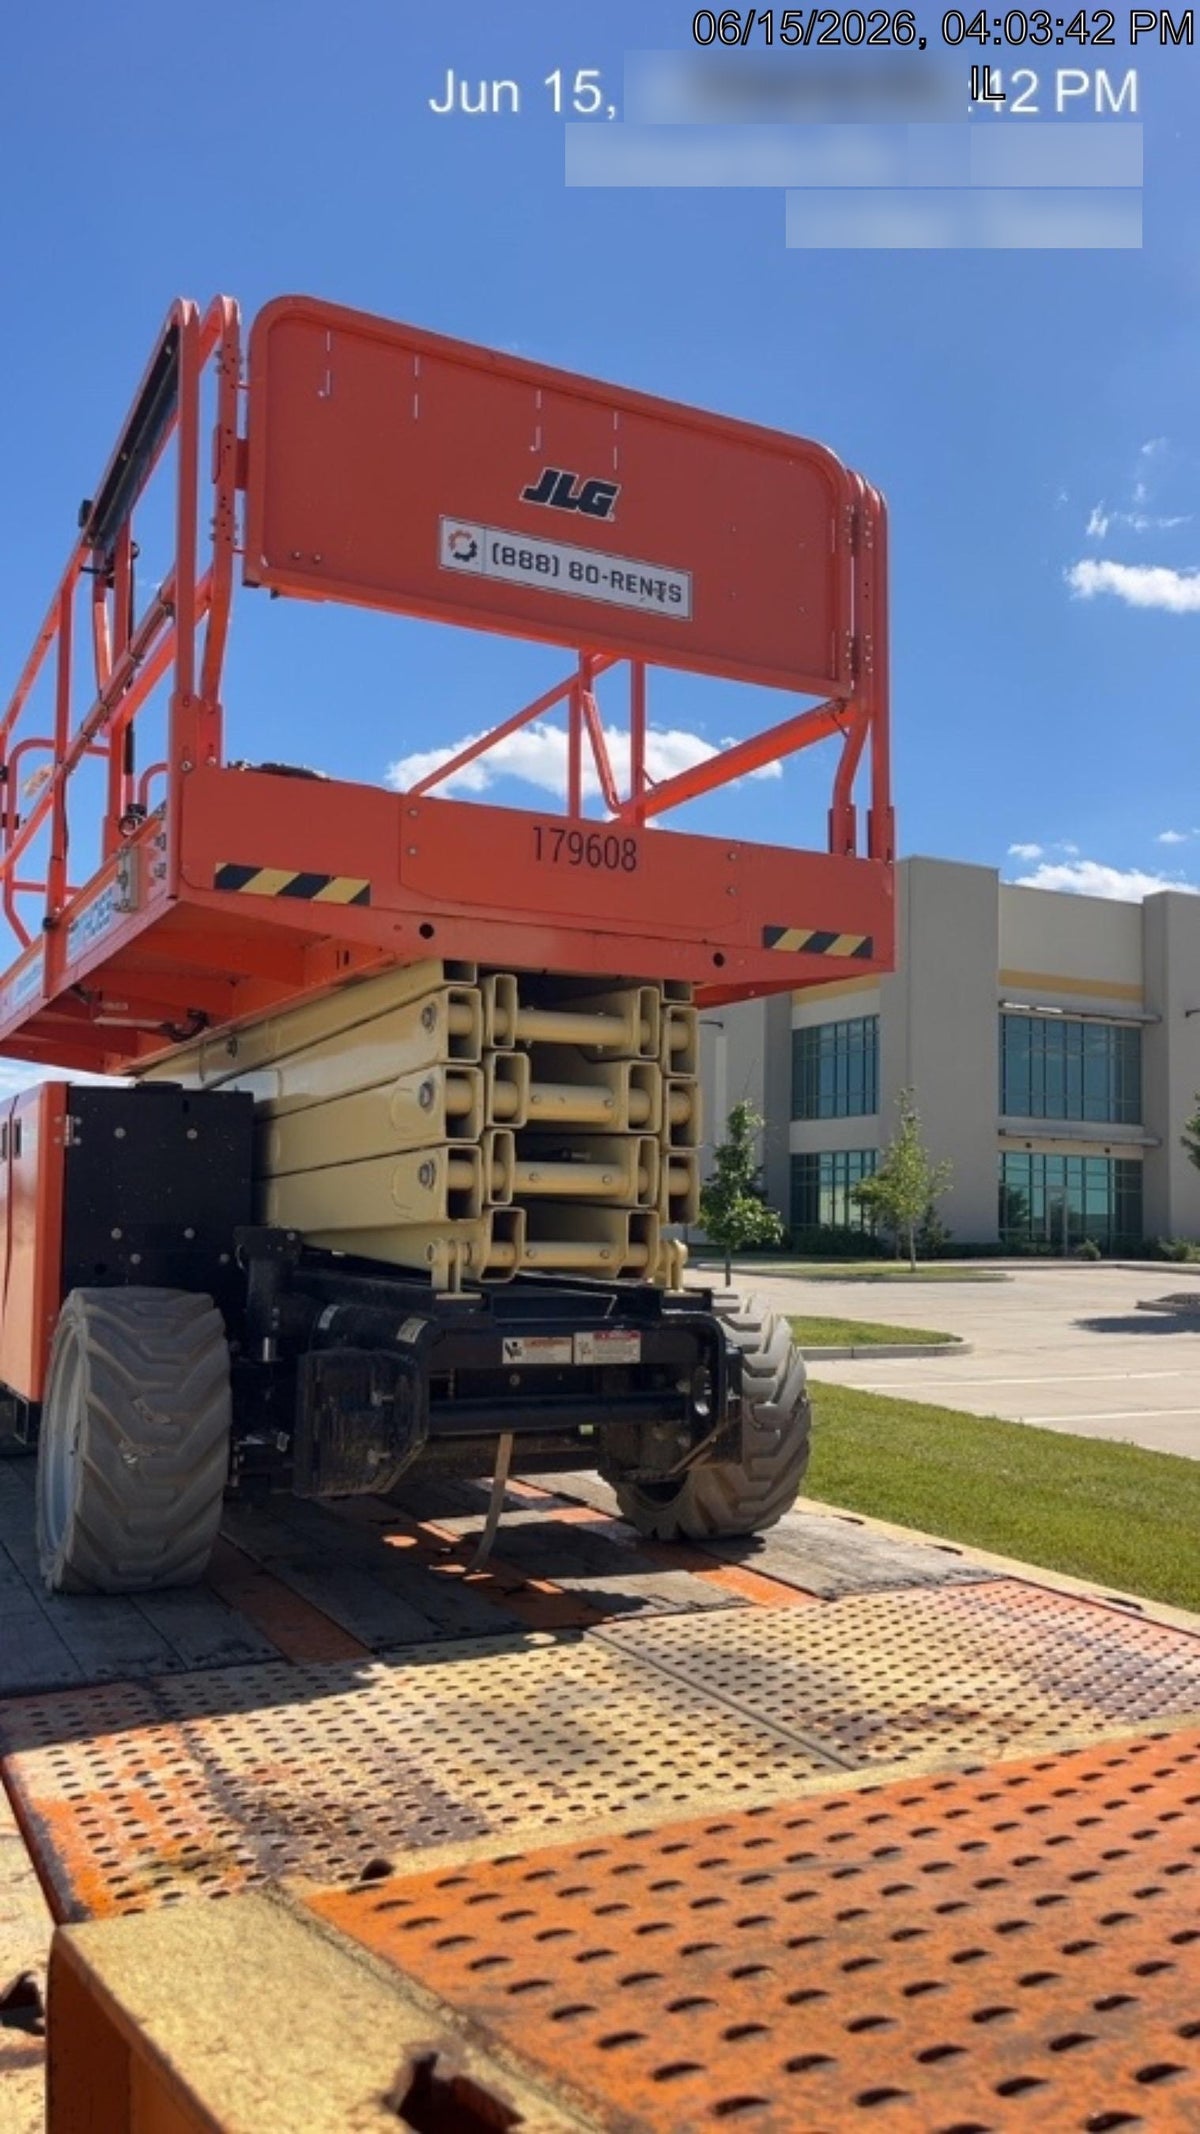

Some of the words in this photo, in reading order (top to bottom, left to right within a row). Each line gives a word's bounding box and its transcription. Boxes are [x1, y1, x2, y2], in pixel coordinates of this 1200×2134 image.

[520, 467, 621, 521] JLG
[492, 542, 560, 577] (888)
[569, 560, 682, 603] 80-RENTS
[532, 826, 638, 872] 179608
